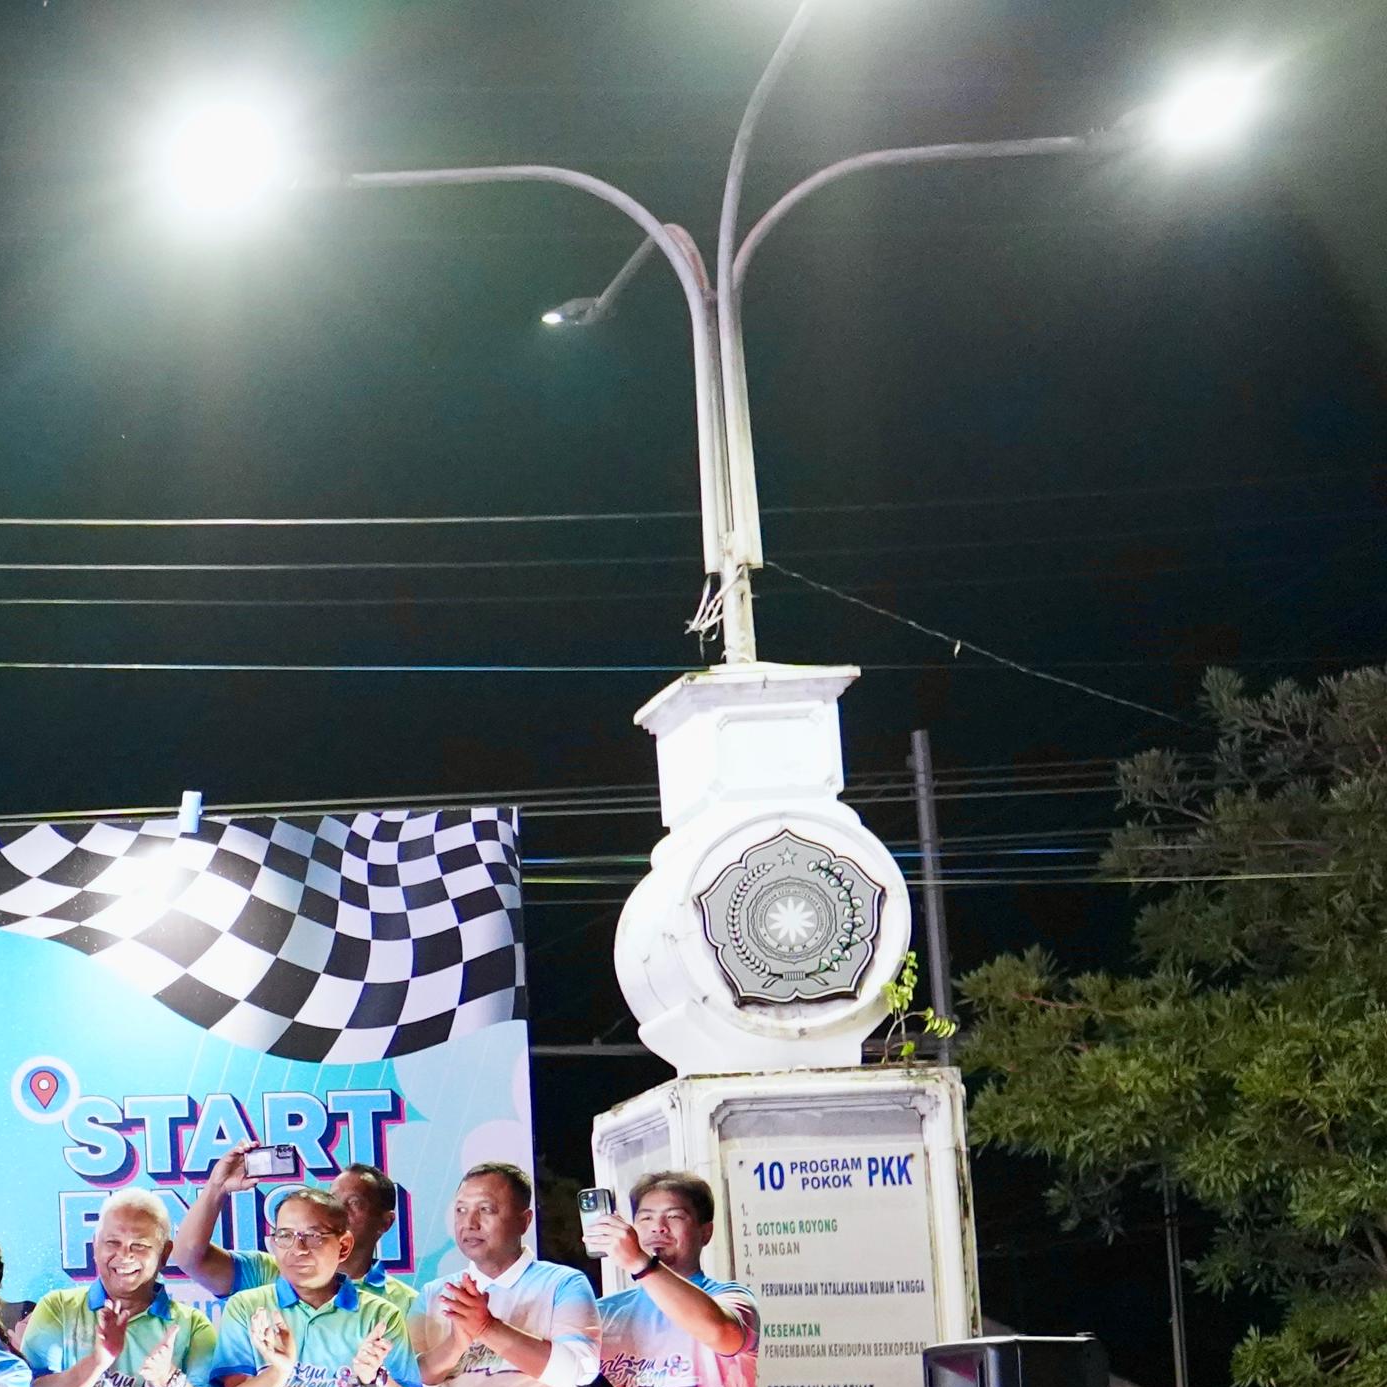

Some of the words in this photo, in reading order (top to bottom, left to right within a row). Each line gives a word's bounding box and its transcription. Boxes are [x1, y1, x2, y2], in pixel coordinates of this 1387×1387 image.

[62, 1089, 395, 1178] START
[753, 1162, 785, 1191] 10
[790, 1157, 862, 1175] PROGRAM
[868, 1154, 913, 1187] PKK
[802, 1174, 853, 1190] POKOK
[756, 1220, 795, 1236] GOTONG
[798, 1219, 838, 1234] ROYONG
[758, 1242, 800, 1256] PANGAN
[761, 1283, 803, 1297] PERUMAHAN
[805, 1282, 818, 1296] DAN
[820, 1281, 868, 1295] TATALAKSANA
[870, 1281, 894, 1294] RUMAH
[896, 1280, 925, 1294] TANGGA
[764, 1323, 820, 1337] KESEHATAN
[765, 1344, 826, 1358] PENGEMBANGAN
[828, 1343, 872, 1357] KEHIDUPAN
